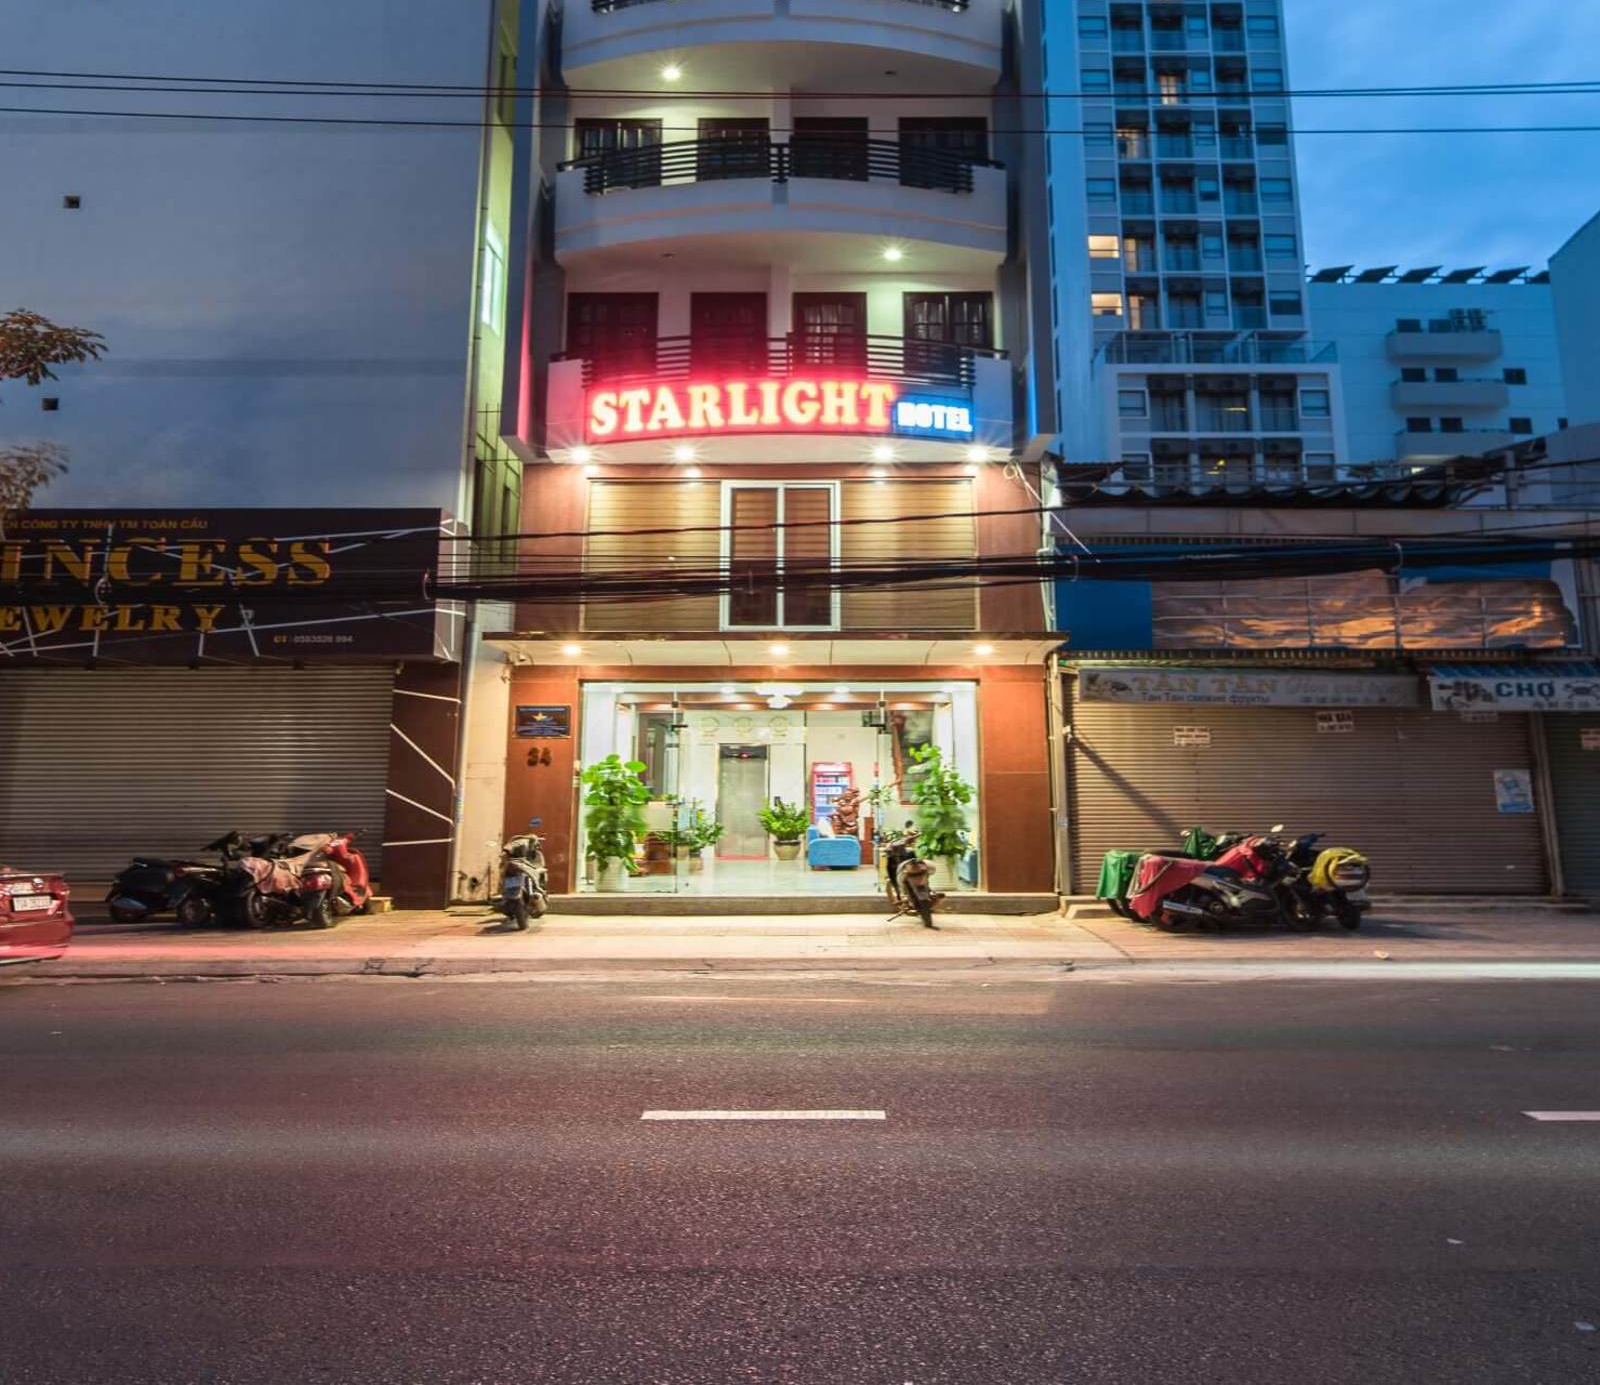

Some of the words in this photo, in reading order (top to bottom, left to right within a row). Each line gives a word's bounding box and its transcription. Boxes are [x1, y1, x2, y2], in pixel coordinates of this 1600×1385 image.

[590, 381, 896, 436] STARLIGHT
[897, 401, 973, 432] HOTEL
[1495, 680, 1556, 700] CHỢ
